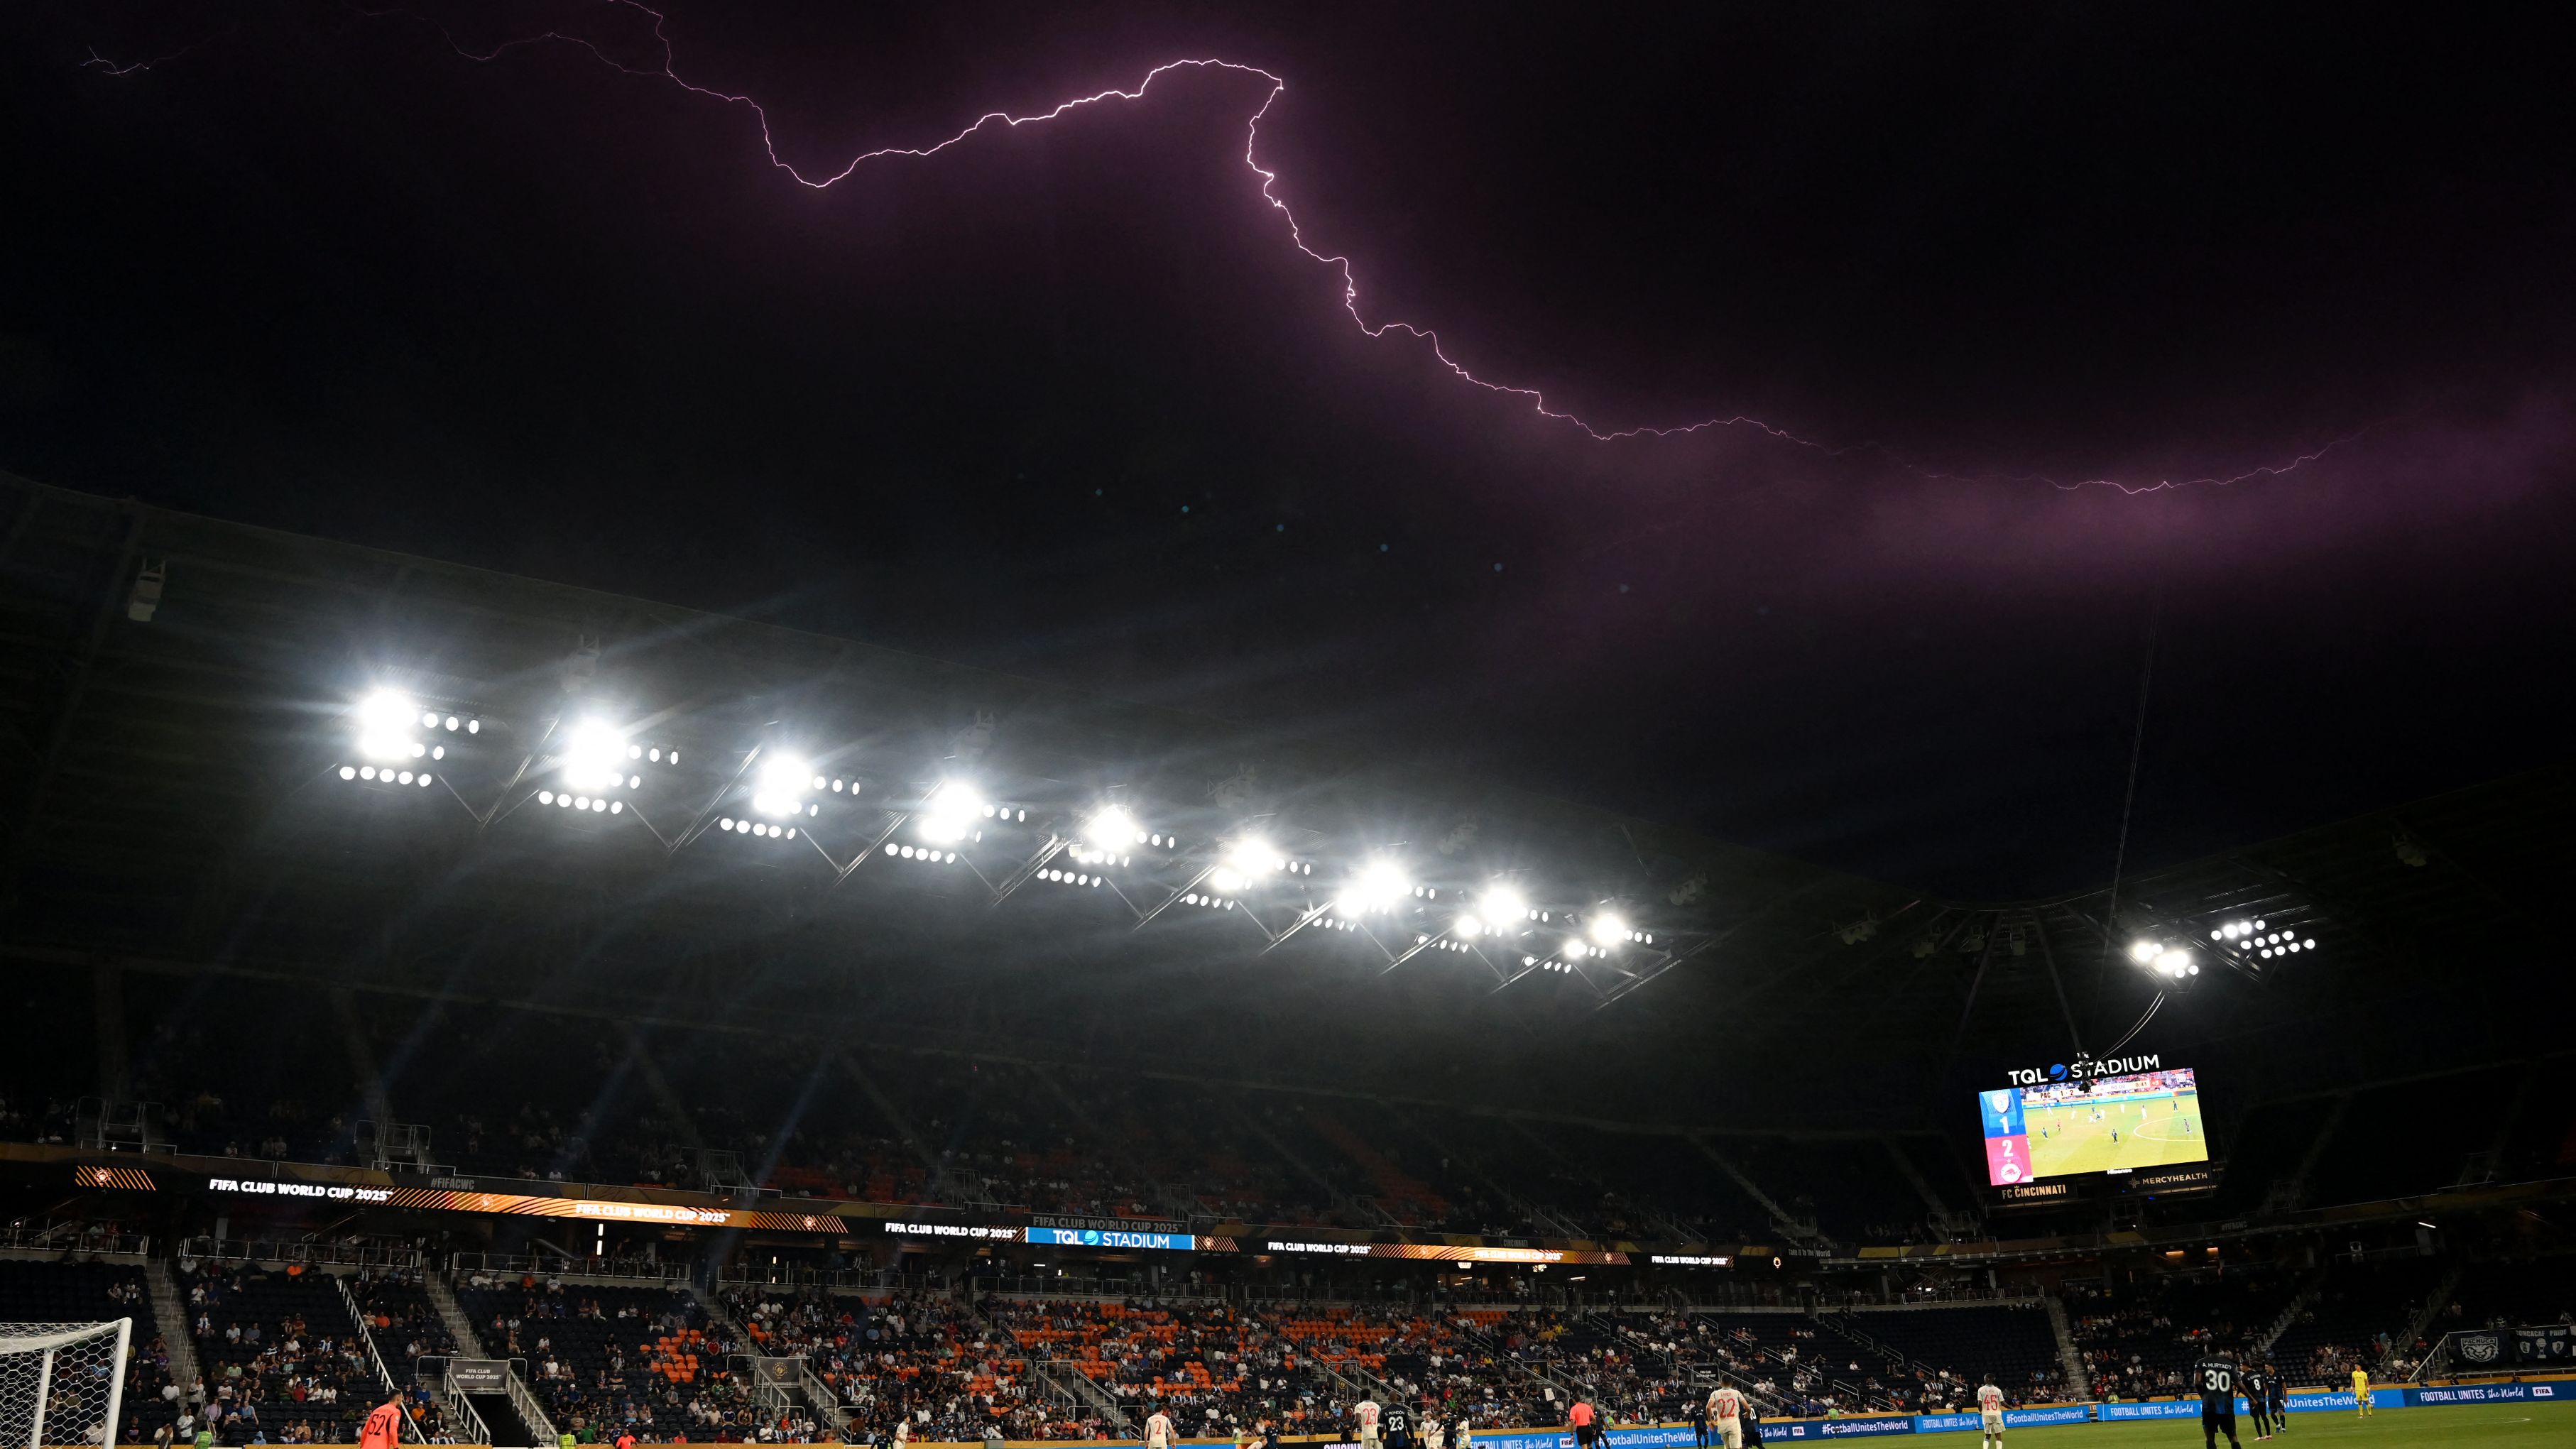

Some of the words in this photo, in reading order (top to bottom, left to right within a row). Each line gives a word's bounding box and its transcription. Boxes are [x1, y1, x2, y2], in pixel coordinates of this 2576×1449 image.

[2008, 1068, 2048, 1086] TQL
[2070, 1054, 2159, 1078] STADIUM
[1999, 1116, 2009, 1134] 1
[2002, 1139, 2014, 1157] 2
[431, 1177, 475, 1190] #FIFACWC
[2143, 1172, 2207, 1186] MERCYHEALTH
[209, 1179, 239, 1191] FIFA
[241, 1181, 275, 1193] CLUB
[278, 1183, 326, 1197] WORLD
[327, 1187, 354, 1198] CUP
[2002, 1189, 2012, 1200] FC
[2014, 1185, 2066, 1197] CINCINNATI
[577, 1204, 600, 1215] FIFA
[603, 1205, 631, 1217] CLUB
[633, 1207, 674, 1220] WORLD
[675, 1210, 698, 1220] CUP
[885, 1223, 906, 1233] FIFA
[907, 1224, 933, 1234] CLUB
[934, 1225, 968, 1236] WORLD
[969, 1227, 988, 1237] CUP
[1034, 1216, 1057, 1228] FIFA
[1058, 1218, 1085, 1230] CLUB
[1087, 1219, 1129, 1231] WORLD
[1131, 1222, 1151, 1232] CUP
[1053, 1230, 1084, 1245] TQL
[1103, 1232, 1169, 1249] STADIUM
[1268, 1242, 1284, 1250] FIFA
[1285, 1243, 1305, 1252] CLUB
[1306, 1244, 1333, 1252] WORLD
[1334, 1245, 1350, 1253] CUP
[2205, 1369, 2230, 1392] 30
[2254, 1378, 2261, 1391] 8
[2420, 1391, 2457, 1401] FOOTBALL
[2457, 1389, 2485, 1401] UNITES
[2487, 1388, 2500, 1399] the
[2500, 1387, 2524, 1398] World
[1718, 1398, 1735, 1418] 22
[1984, 1394, 1998, 1411] 45
[2110, 1406, 2140, 1416] FOOTBALL
[2140, 1405, 2163, 1416] UNITES
[2163, 1406, 2173, 1415] the
[2174, 1404, 2193, 1414] World
[1363, 1409, 1377, 1426] 23
[1388, 1416, 1404, 1431] 23
[1923, 1418, 1943, 1428] FOOTBALL
[2007, 1410, 2084, 1423] #FootballUnitesTheWorld
[369, 1414, 386, 1436] 52
[1155, 1420, 1162, 1435] 2
[1502, 1439, 1524, 1449] UNITES
[1524, 1438, 1534, 1449] the
[1535, 1438, 1553, 1449] World
